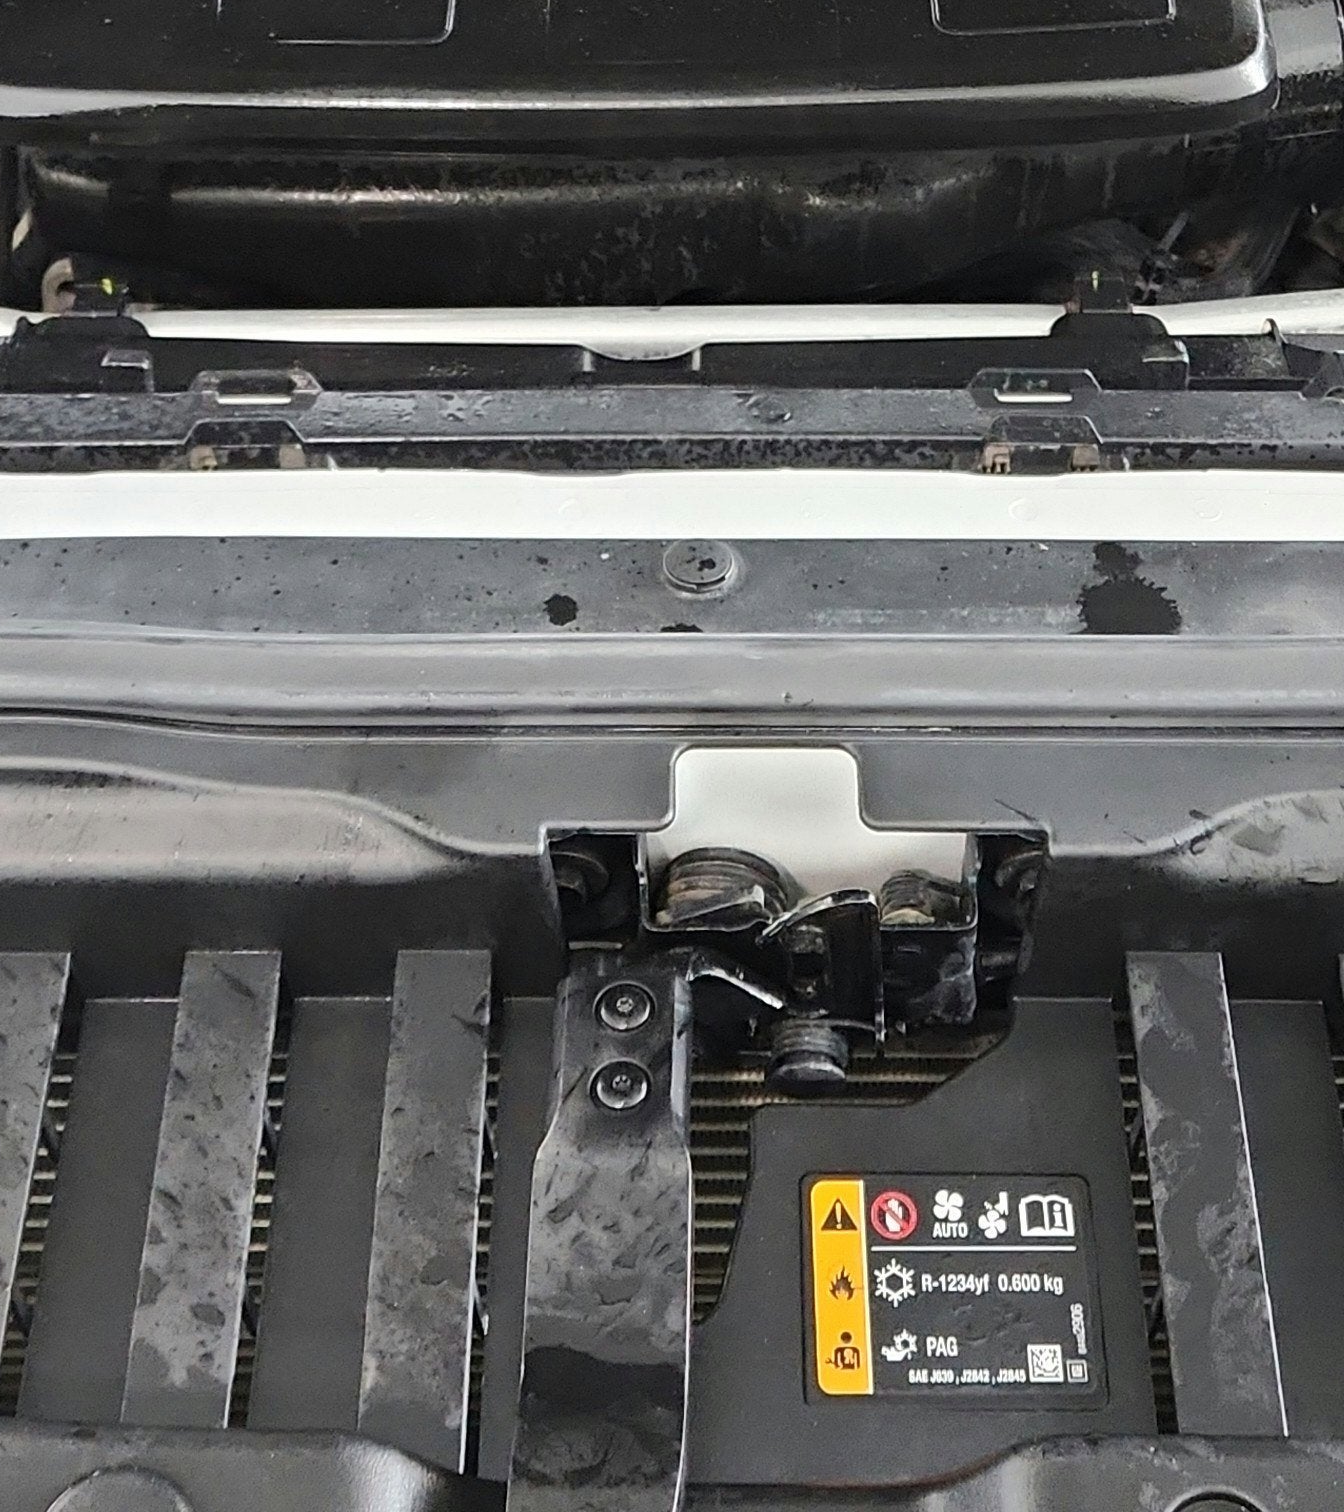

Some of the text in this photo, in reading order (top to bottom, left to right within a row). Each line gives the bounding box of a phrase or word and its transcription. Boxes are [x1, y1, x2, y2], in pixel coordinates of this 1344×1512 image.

[932, 1221, 969, 1238] AUTO
[921, 1273, 1064, 1296] R-1234yf 0.600 kg
[925, 1335, 959, 1357] PAG
[908, 1368, 929, 1384] SAE
